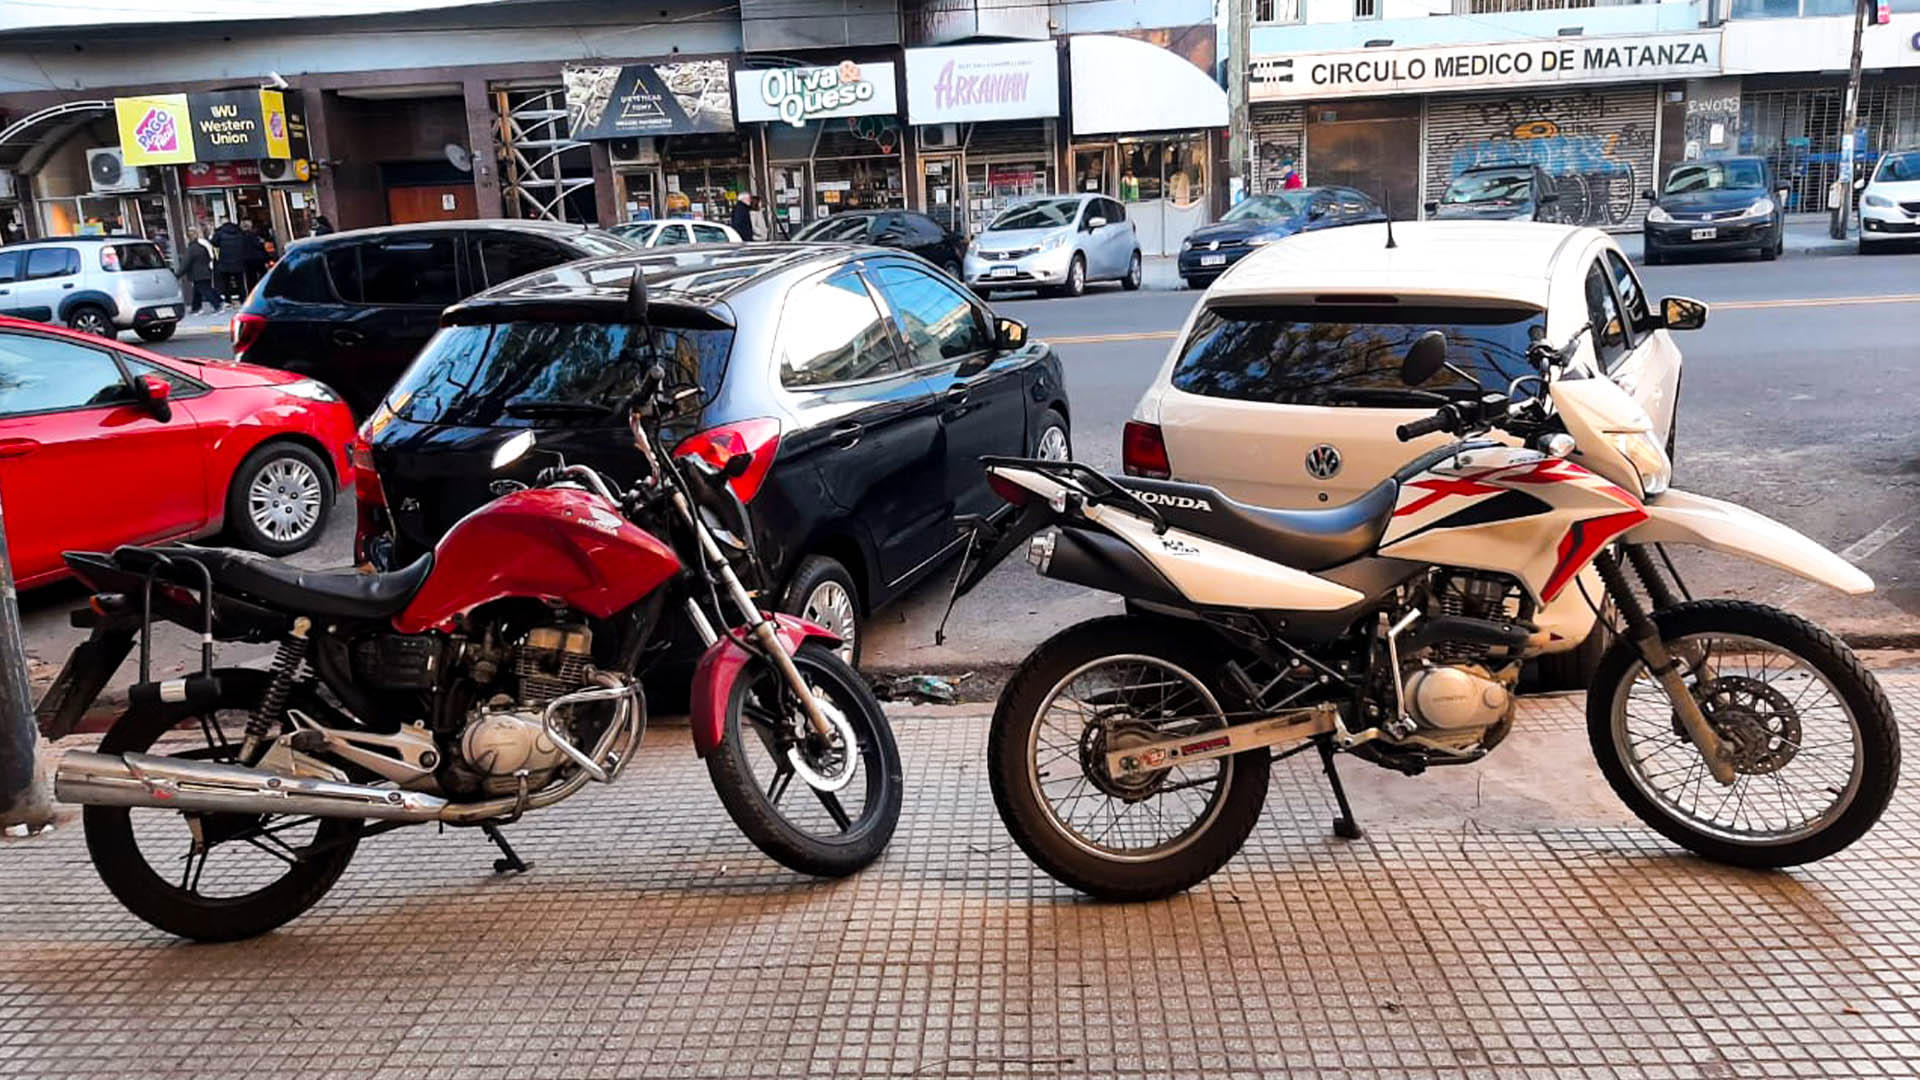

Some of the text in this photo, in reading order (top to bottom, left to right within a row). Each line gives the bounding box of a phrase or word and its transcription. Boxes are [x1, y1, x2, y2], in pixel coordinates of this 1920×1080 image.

[1311, 43, 1708, 85] CIRCULO MEDICO DE MATANZA
[762, 67, 839, 106] Oliva
[780, 82, 873, 127] Queso
[138, 111, 168, 148] PAGO
[200, 120, 255, 133] Western
[210, 132, 248, 145] Union
